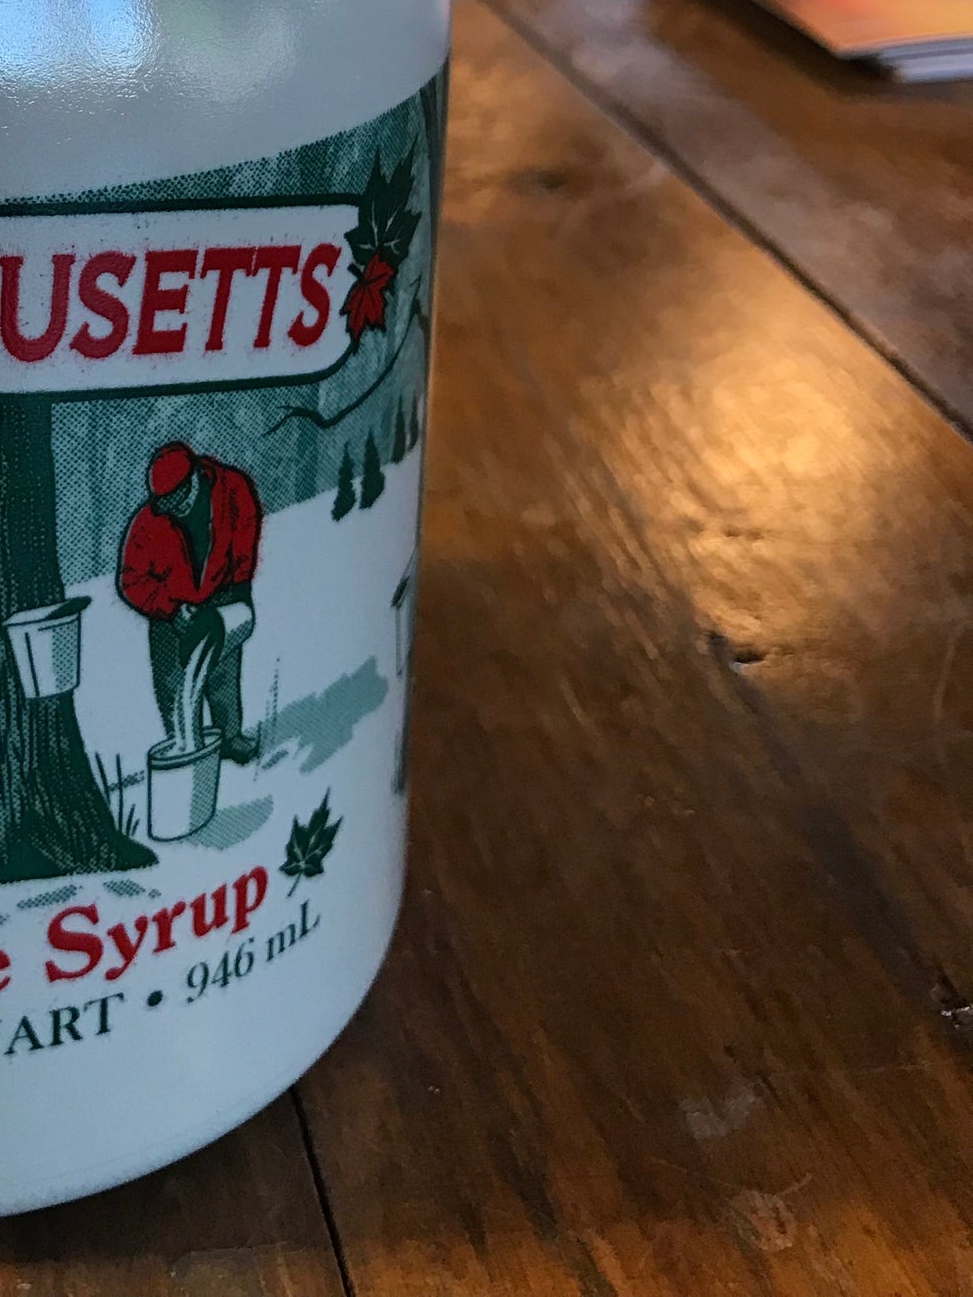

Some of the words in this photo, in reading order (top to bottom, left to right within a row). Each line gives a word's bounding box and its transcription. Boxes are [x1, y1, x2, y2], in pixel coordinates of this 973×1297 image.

[45, 865, 269, 982] Syrup
[185, 936, 256, 1004] 946
[266, 899, 322, 963] mL
